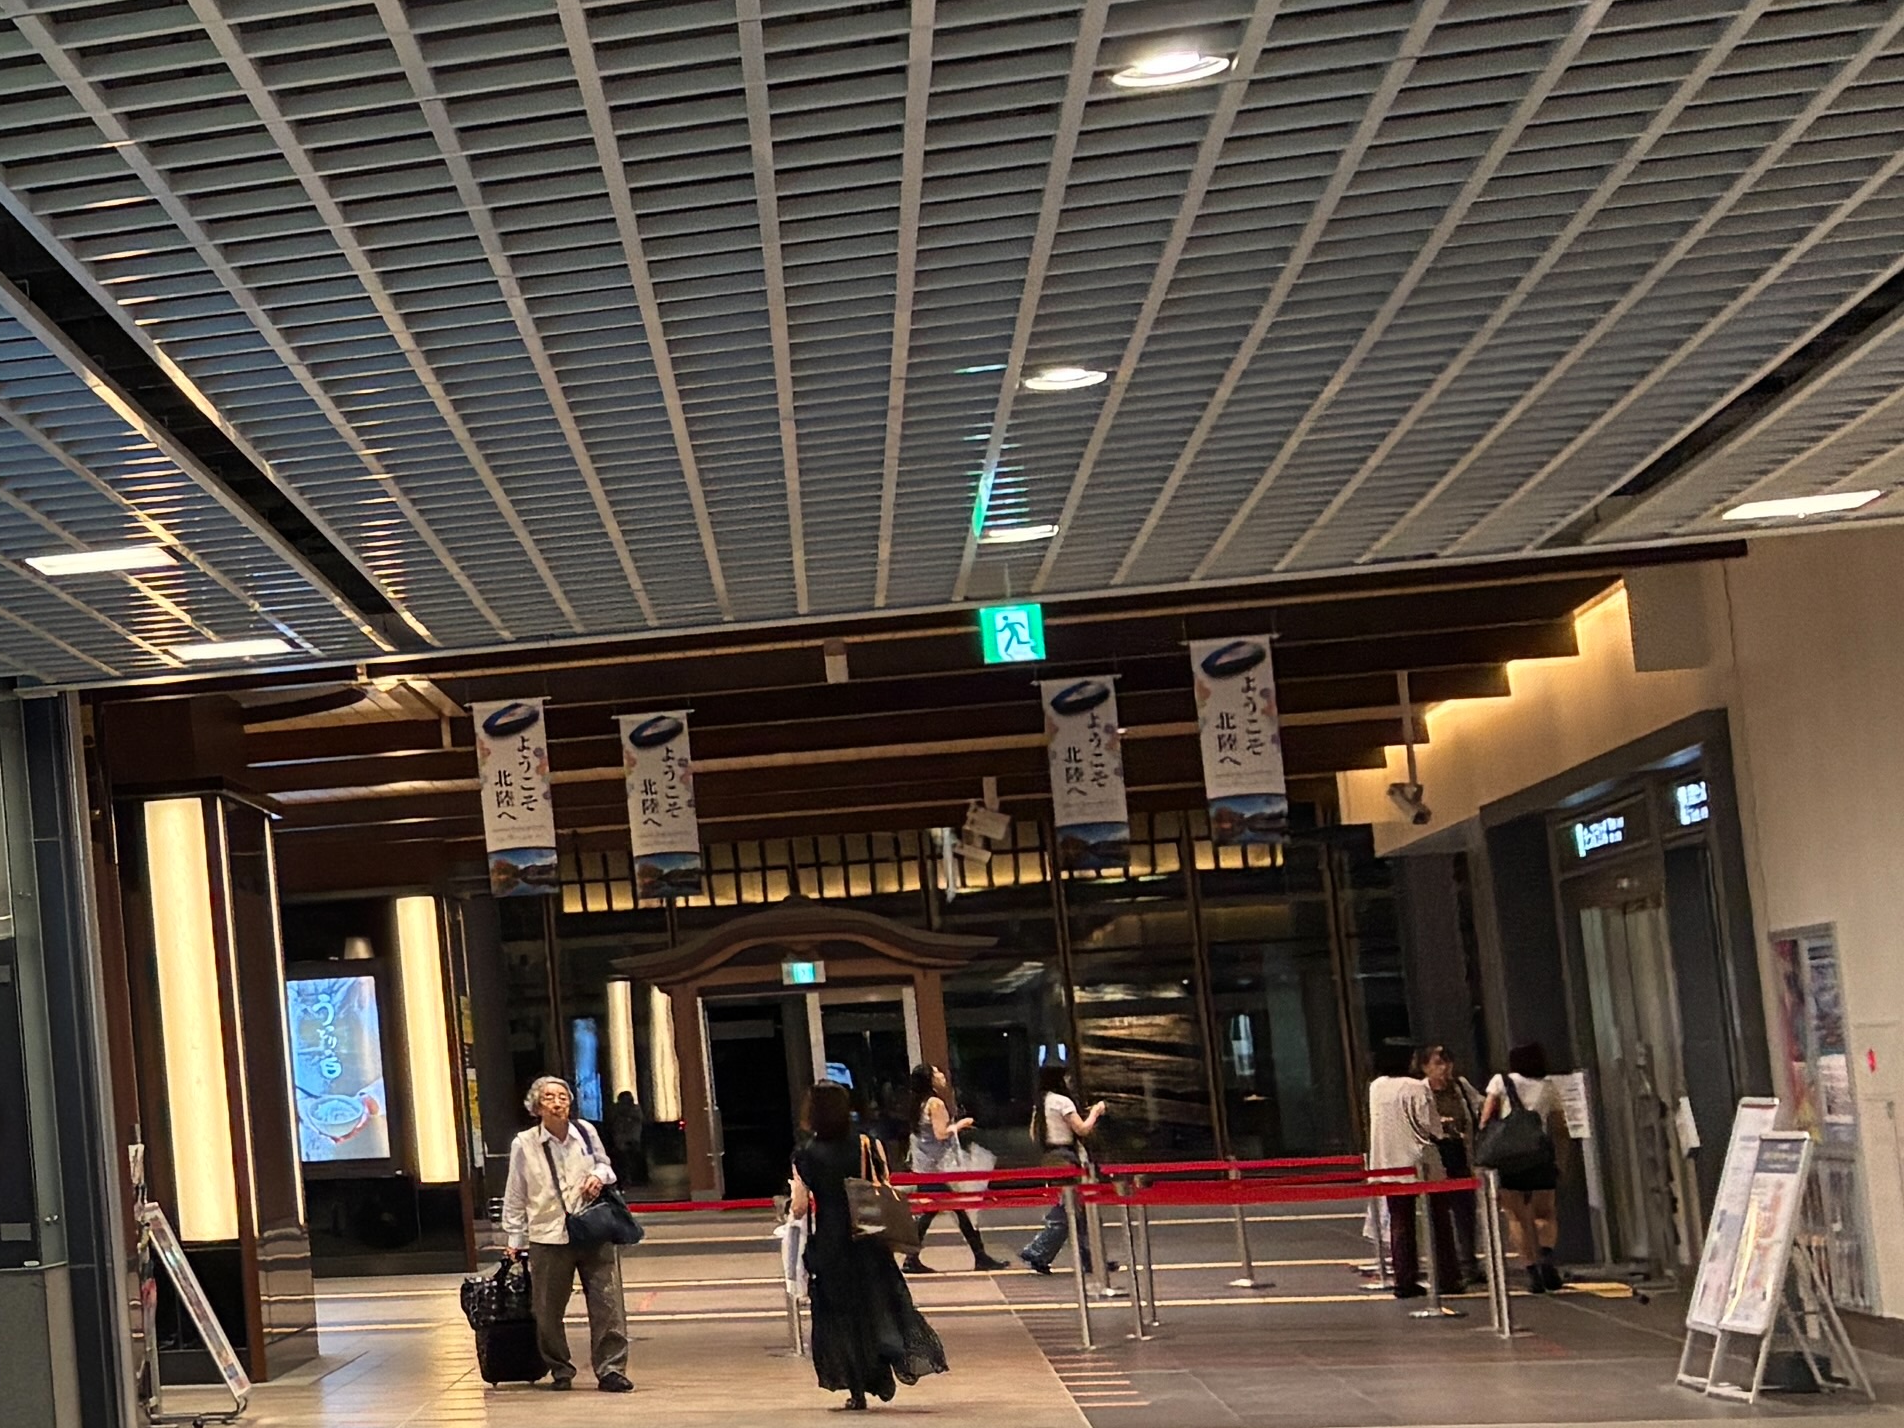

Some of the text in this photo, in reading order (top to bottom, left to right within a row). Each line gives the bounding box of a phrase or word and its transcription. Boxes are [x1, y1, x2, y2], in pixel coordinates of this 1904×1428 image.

[1241, 676, 1265, 756] ようこそ
[494, 770, 517, 820] 北陸へ
[517, 735, 538, 811] ようこそ
[640, 778, 662, 827] 北陸へ
[662, 746, 682, 818] ようこそ
